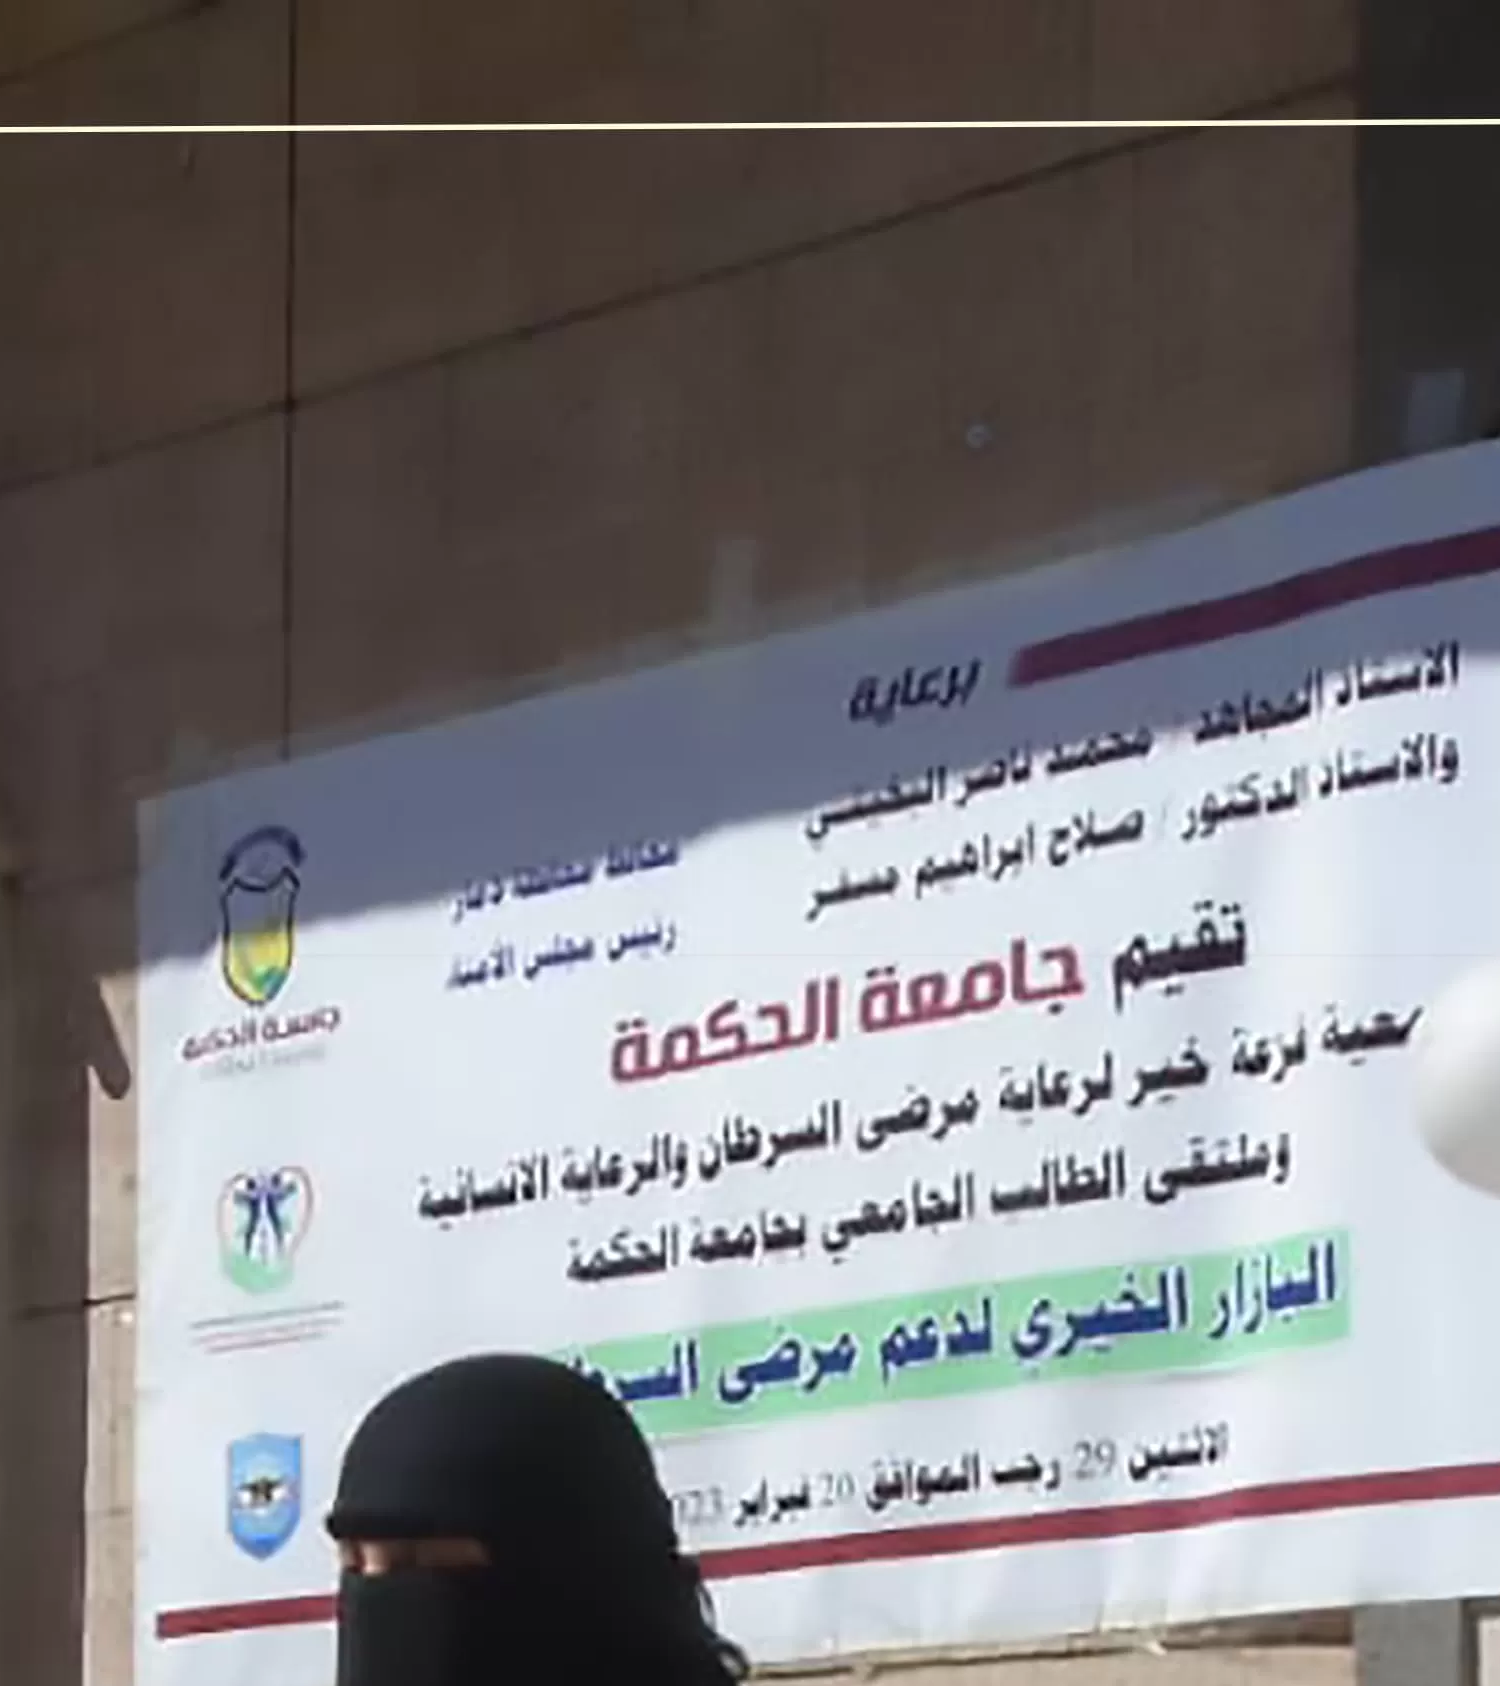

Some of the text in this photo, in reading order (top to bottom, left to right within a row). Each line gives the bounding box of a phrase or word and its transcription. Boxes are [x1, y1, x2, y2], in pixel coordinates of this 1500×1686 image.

[850, 657, 982, 727] برعاية
[1181, 764, 1308, 841] الدكتور
[915, 823, 1035, 901] ابراهيم
[609, 900, 1247, 1084] تقيم جامعة الحكمة
[998, 1050, 1114, 1124] لرعاية
[1128, 1038, 1210, 1105] خير
[700, 1098, 841, 1181] السرطان
[858, 1085, 980, 1152] مرضى
[560, 1131, 690, 1205] والرعاية
[988, 1146, 1124, 1228] الطالب
[564, 1225, 680, 1284] الحكمة
[688, 1206, 806, 1266] بجامعة
[821, 1172, 974, 1265] الجامعي
[1010, 1267, 1188, 1377] الخيري
[1208, 1240, 1336, 1340] البازار
[720, 1325, 858, 1404] مرضى
[880, 1297, 992, 1388] لدعم
[866, 1450, 980, 1512] الموافق
[992, 1452, 1060, 1491] رجب
[1074, 1438, 1117, 1480] 29
[733, 1475, 809, 1528] فبراير
